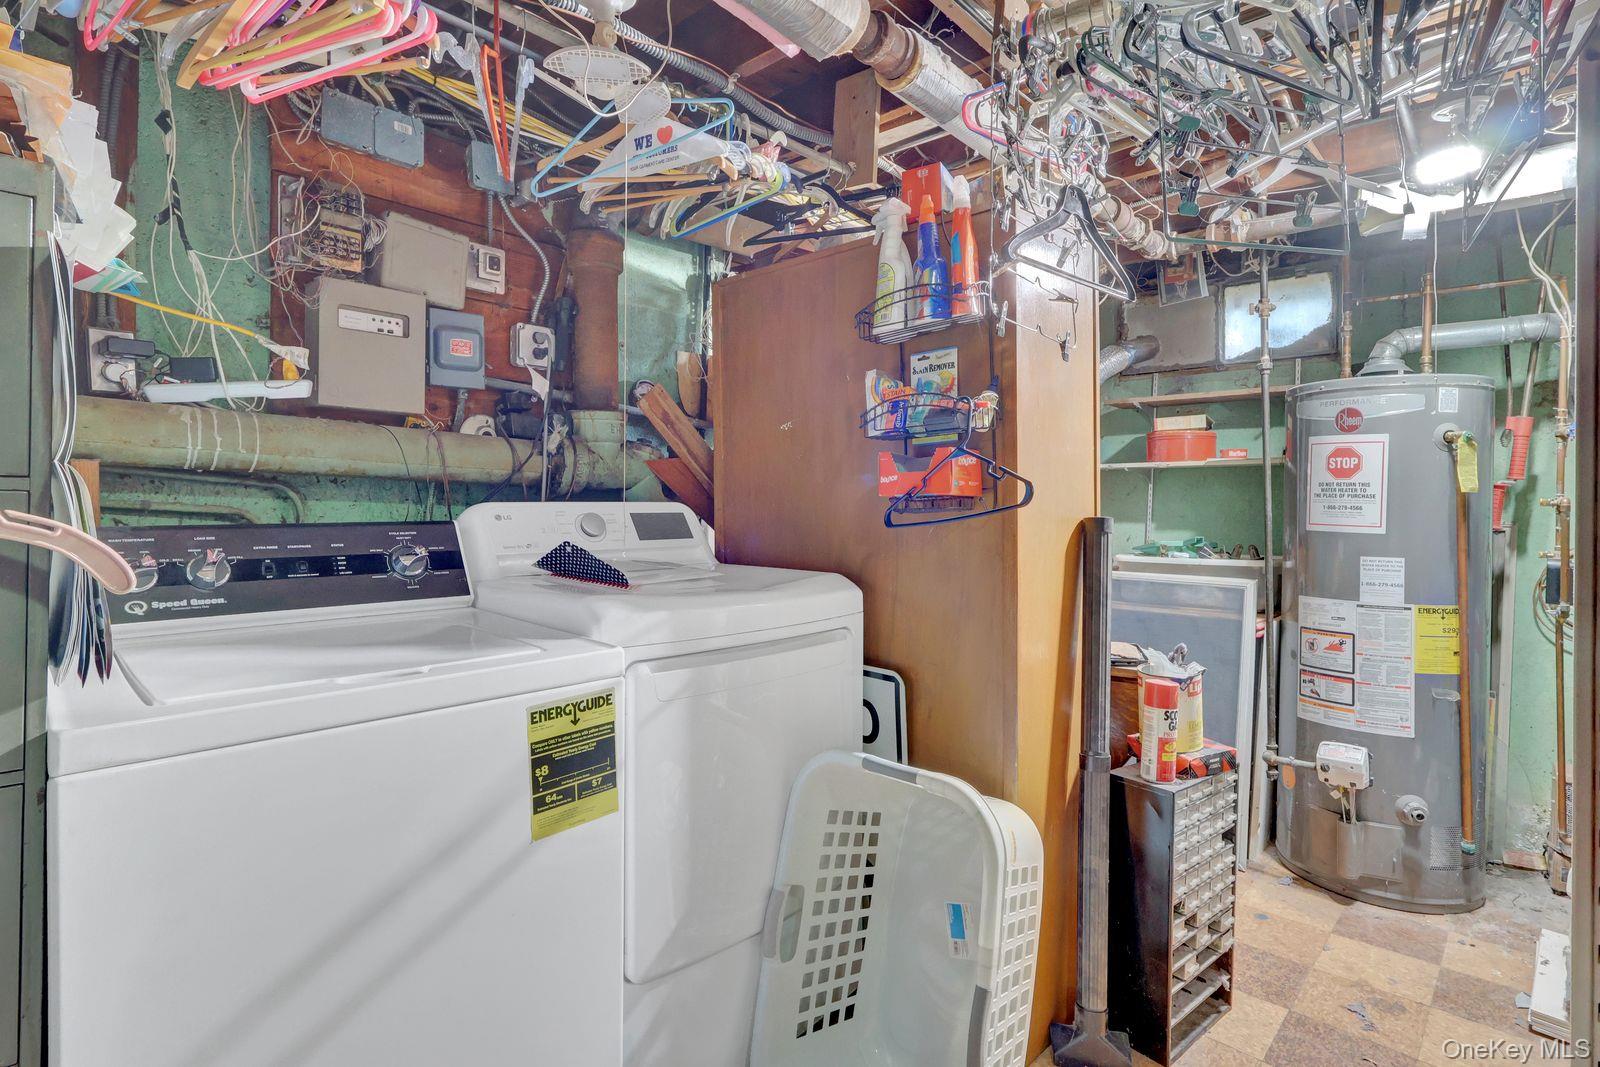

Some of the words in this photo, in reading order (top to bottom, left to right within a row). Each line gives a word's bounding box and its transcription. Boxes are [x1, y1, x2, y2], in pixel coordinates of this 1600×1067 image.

[634, 134, 652, 150] WE
[912, 366, 928, 375] STAIN
[929, 362, 956, 372] REMOVER
[1338, 408, 1362, 430] Rheem
[958, 457, 976, 466] bounce
[1328, 458, 1358, 468] STOP
[151, 599, 187, 608] Speed
[530, 694, 612, 725] ENERGYGUIDE
[535, 765, 549, 776] $8
[592, 777, 602, 787] $7
[546, 793, 556, 803] 64
